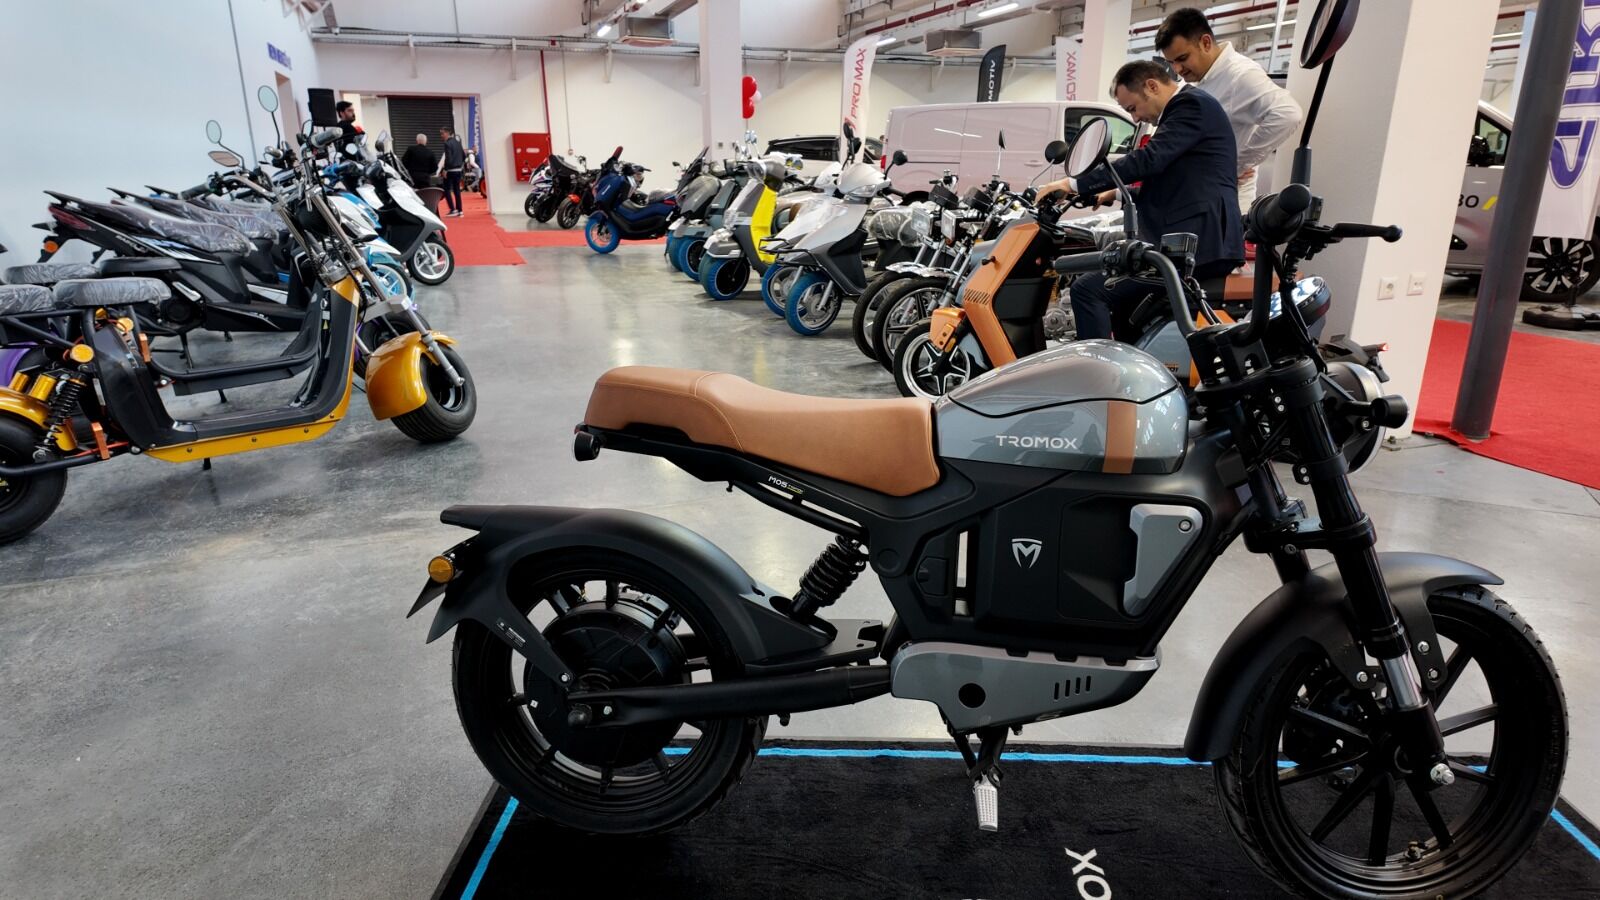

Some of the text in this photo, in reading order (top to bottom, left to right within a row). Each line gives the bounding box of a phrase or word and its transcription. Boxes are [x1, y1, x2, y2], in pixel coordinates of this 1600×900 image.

[850, 48, 867, 118] PRO MAX
[995, 435, 1078, 449] TROMOX
